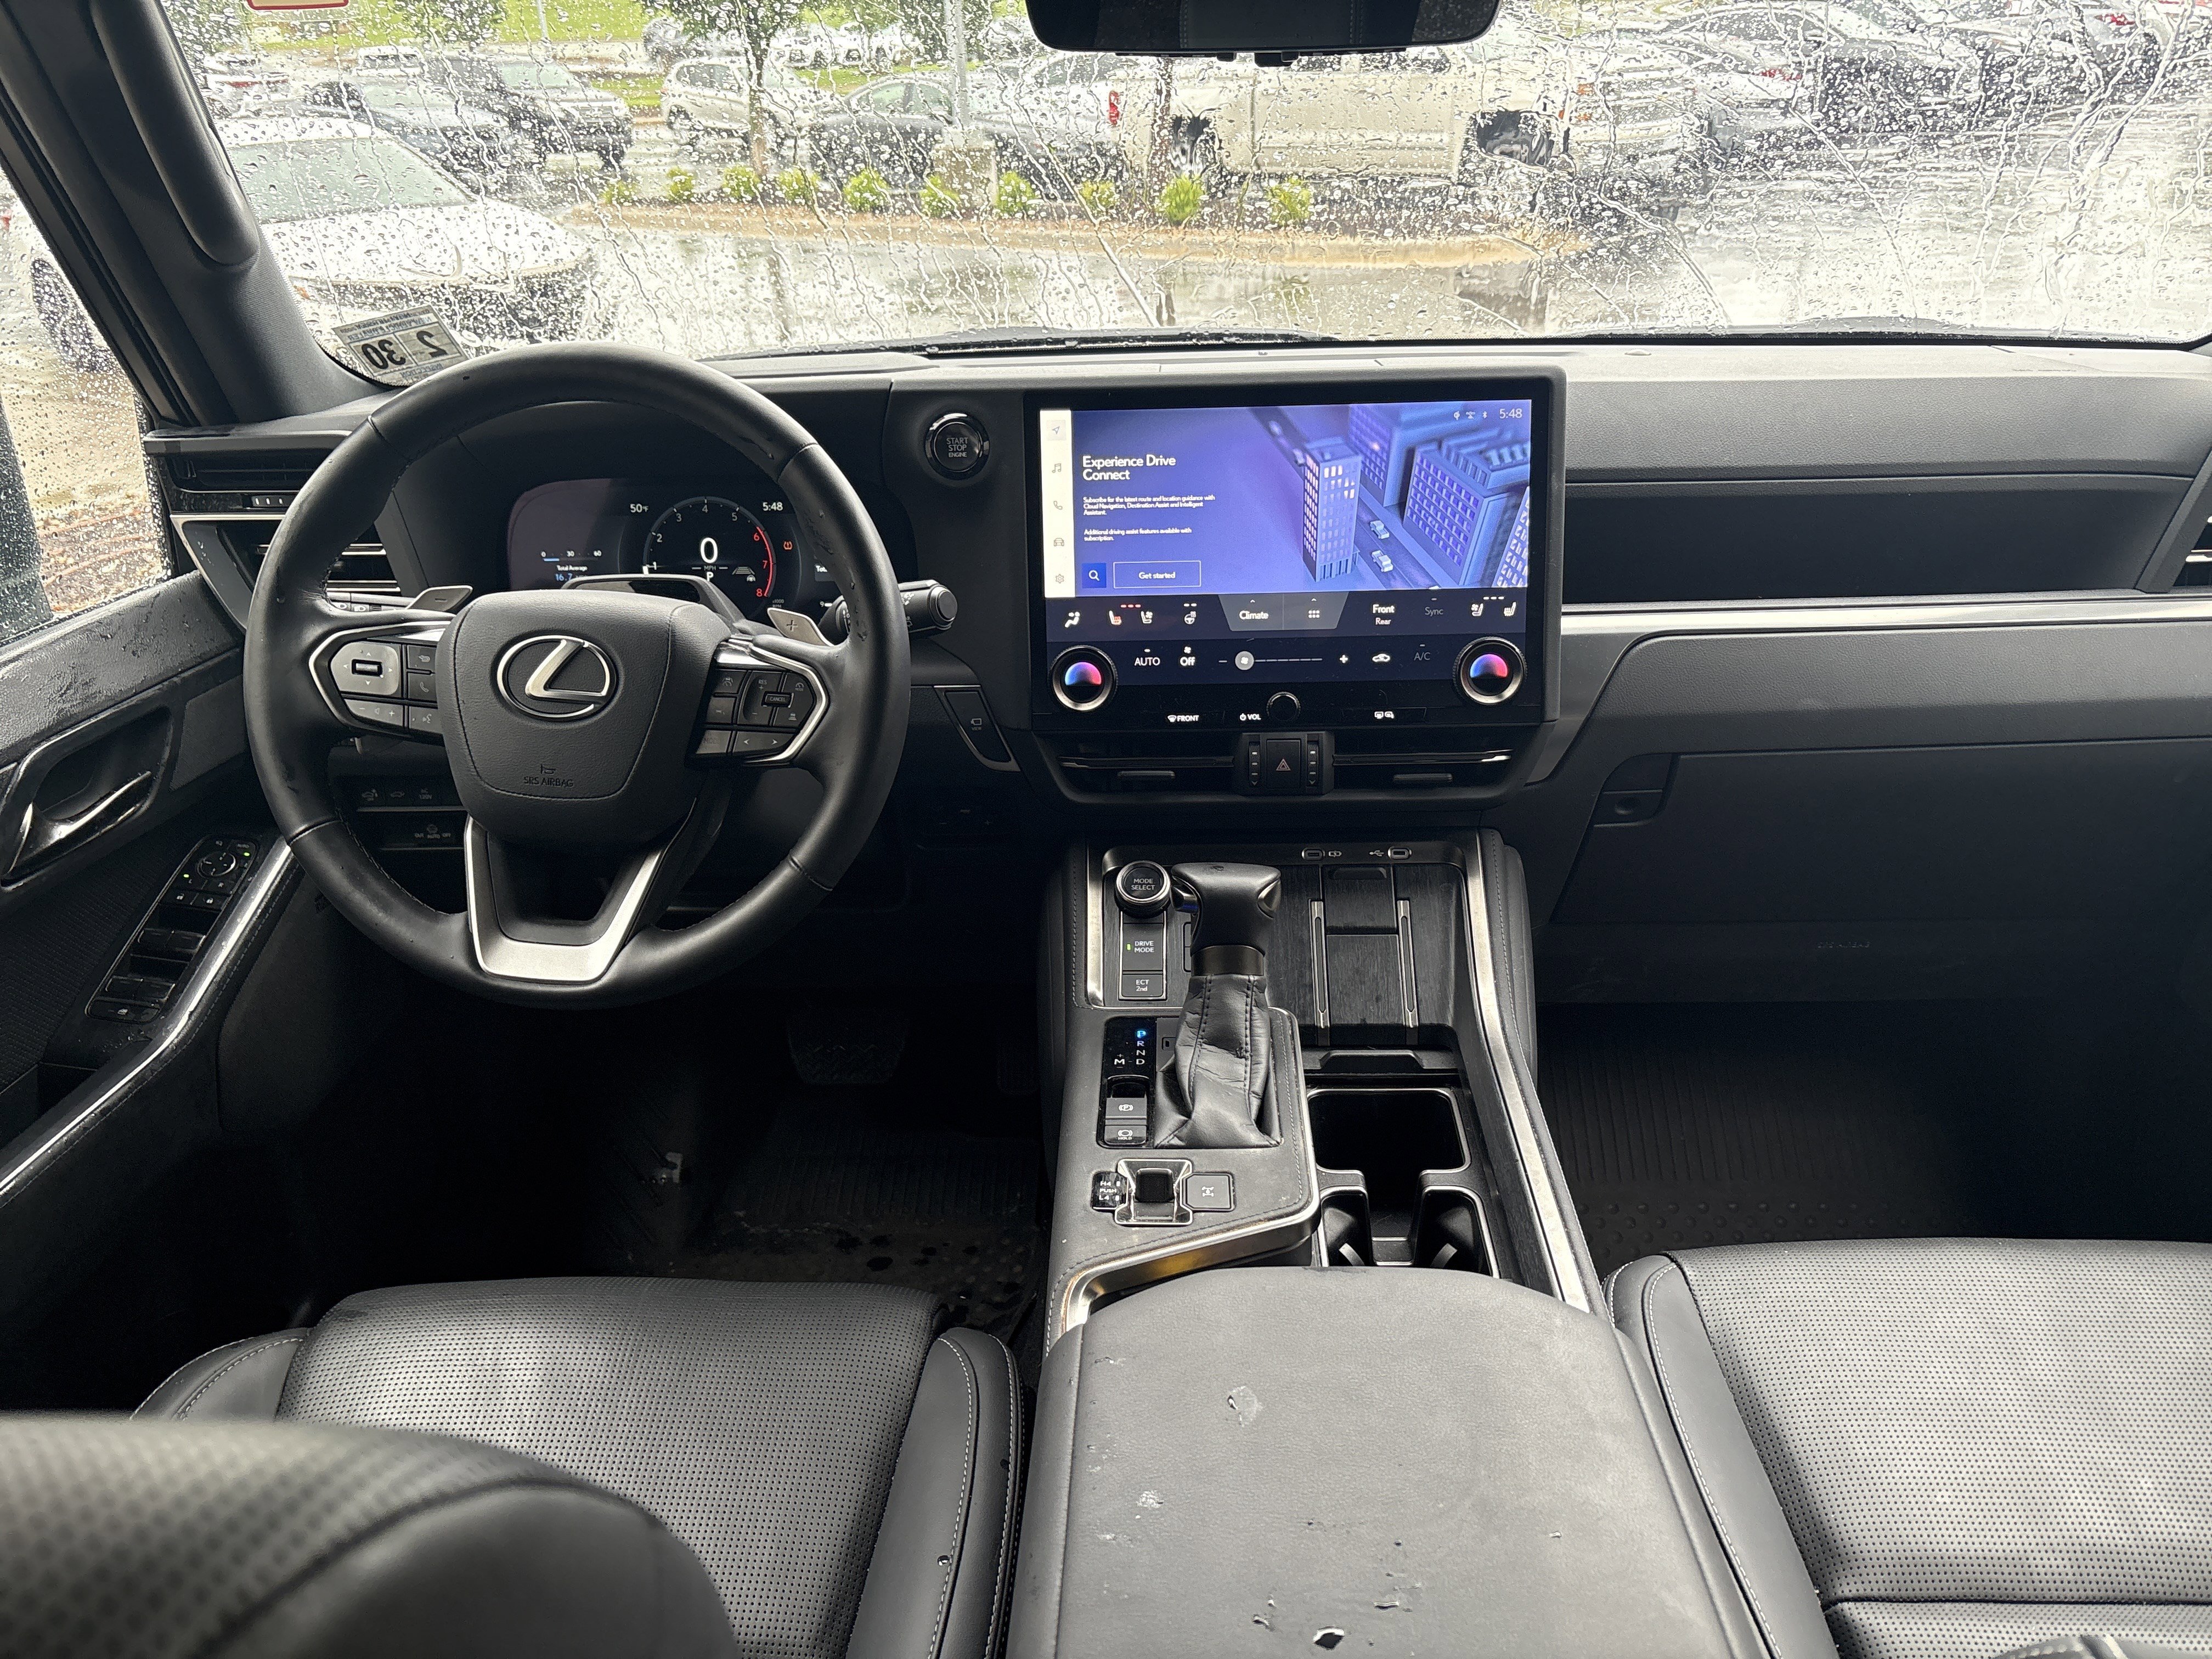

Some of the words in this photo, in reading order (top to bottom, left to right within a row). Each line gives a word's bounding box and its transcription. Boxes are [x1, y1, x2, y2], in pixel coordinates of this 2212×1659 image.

[1499, 408, 1522, 419] 5:48
[1082, 455, 1144, 470] Experience
[1146, 454, 1176, 466] Drive
[1082, 469, 1131, 481] Connect
[763, 502, 783, 511] 5:48
[676, 514, 682, 522] 3
[731, 512, 737, 521] 5
[657, 534, 662, 543] 2
[701, 537, 718, 563] 0
[652, 562, 657, 570] 1
[762, 560, 768, 569] 7
[555, 573, 573, 581] 16.7
[707, 572, 713, 582] P
[756, 588, 762, 597] 8
[1373, 604, 1395, 613] Front
[1425, 607, 1443, 617] Sync
[1239, 611, 1269, 619] Climate
[1180, 656, 1195, 666] Off
[1414, 652, 1431, 661] A/C
[1134, 657, 1160, 666] AUTO
[524, 776, 539, 785] SRS
[541, 777, 574, 787] AIRBAG
